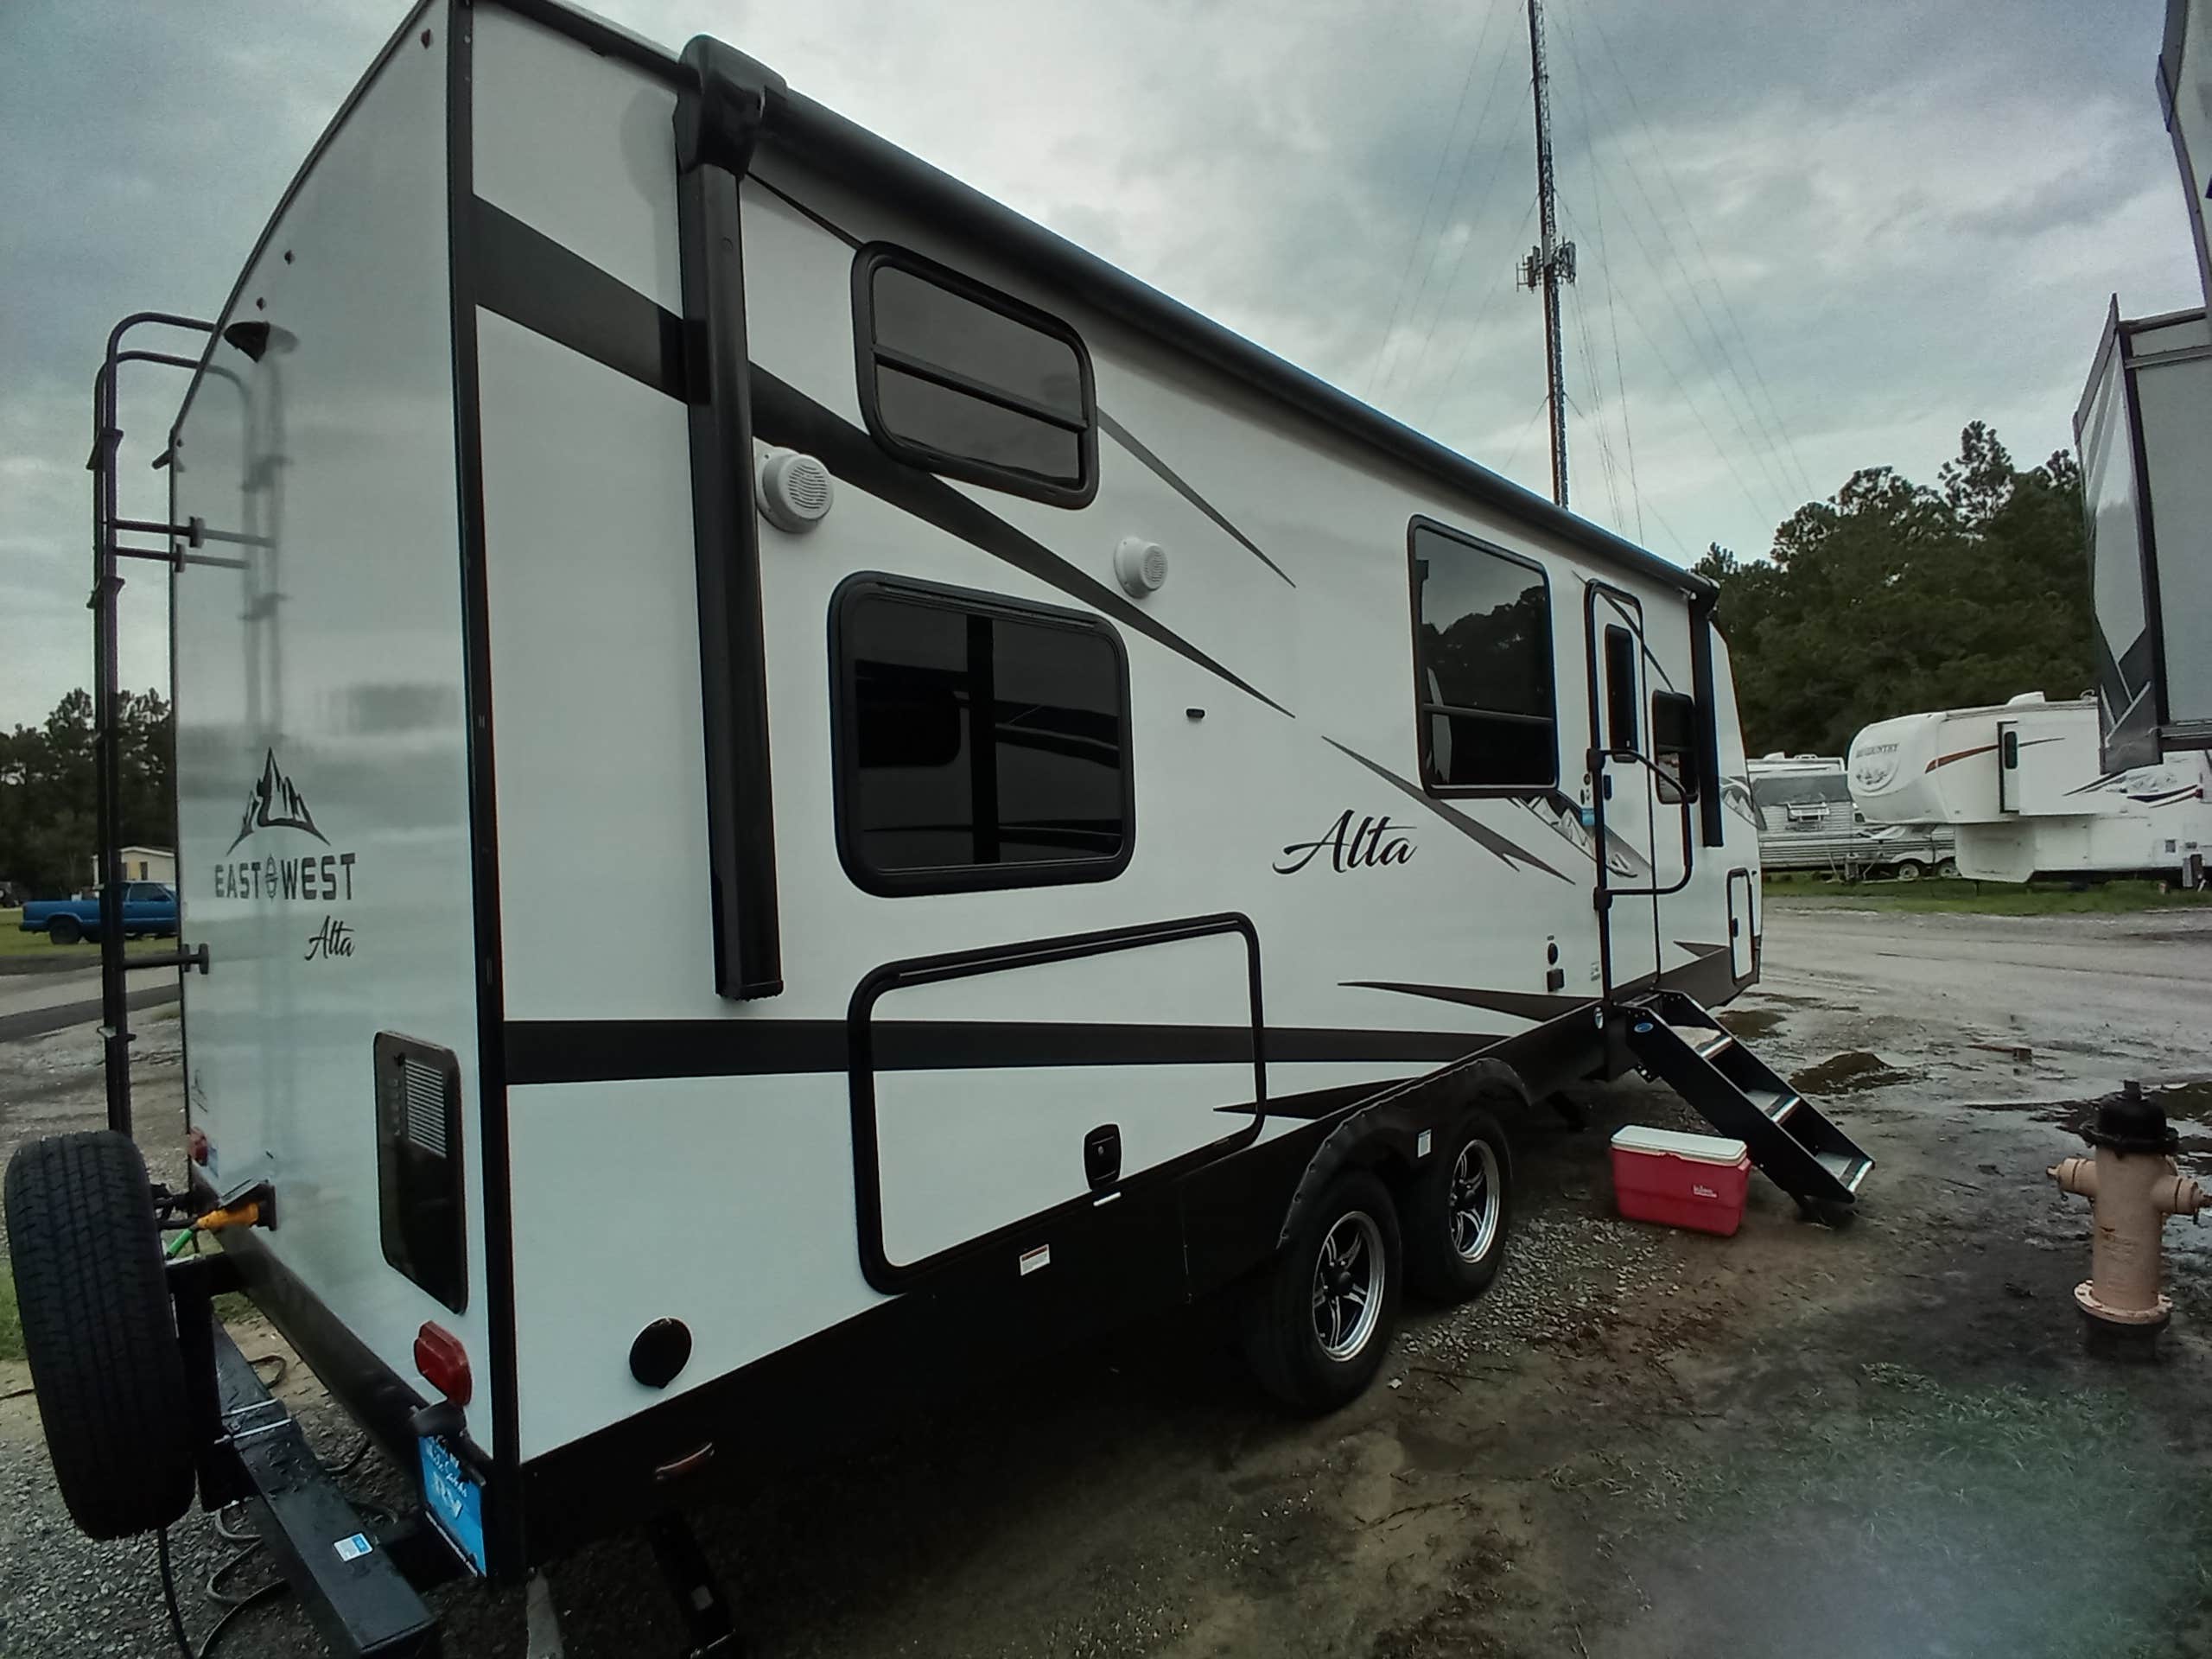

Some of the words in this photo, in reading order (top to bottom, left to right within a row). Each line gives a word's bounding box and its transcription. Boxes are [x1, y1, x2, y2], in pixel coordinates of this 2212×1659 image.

[1272, 809, 1417, 874] Alta
[215, 862, 260, 899] EAST
[281, 853, 355, 900] WEST
[305, 915, 355, 961] Alta
